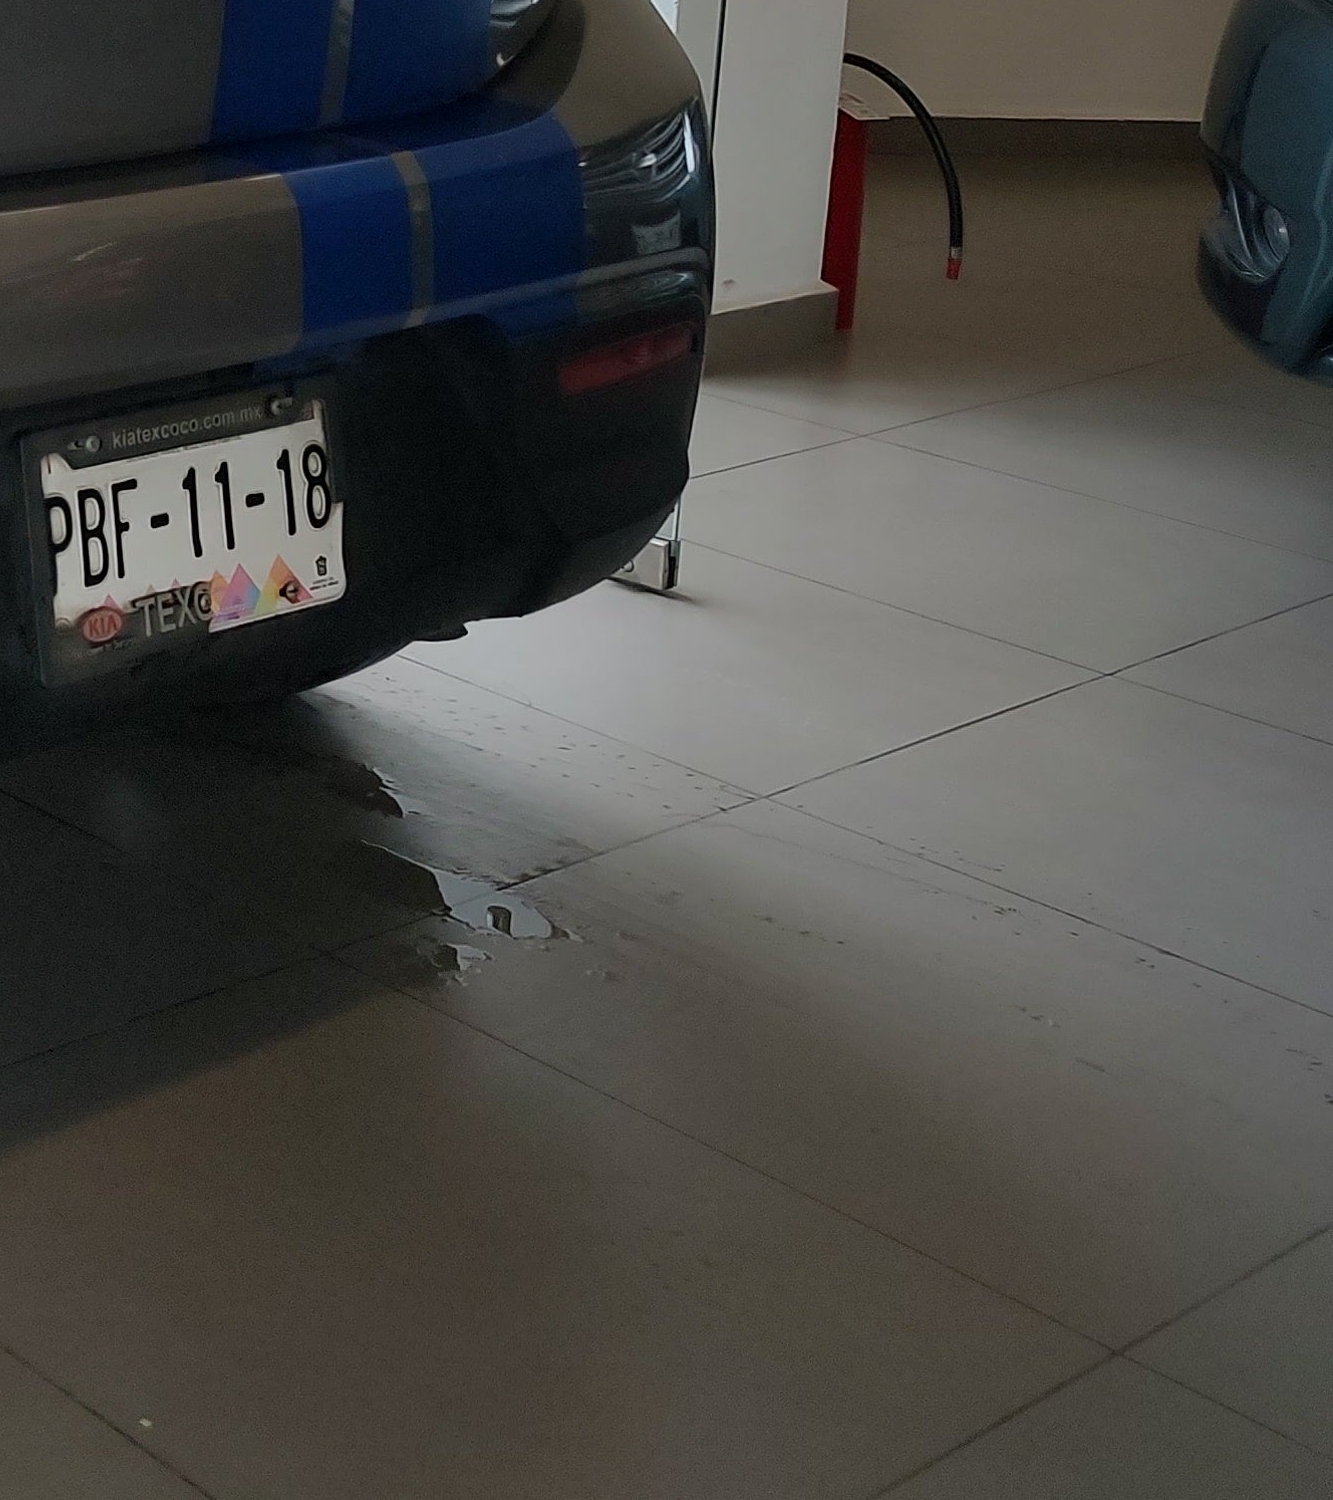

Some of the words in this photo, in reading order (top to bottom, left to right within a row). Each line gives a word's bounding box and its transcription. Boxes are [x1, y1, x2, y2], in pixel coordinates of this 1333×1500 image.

[111, 405, 263, 450] kiatexcoco.com.mx
[44, 443, 332, 588] PBF-11-18
[88, 614, 118, 637] KIA
